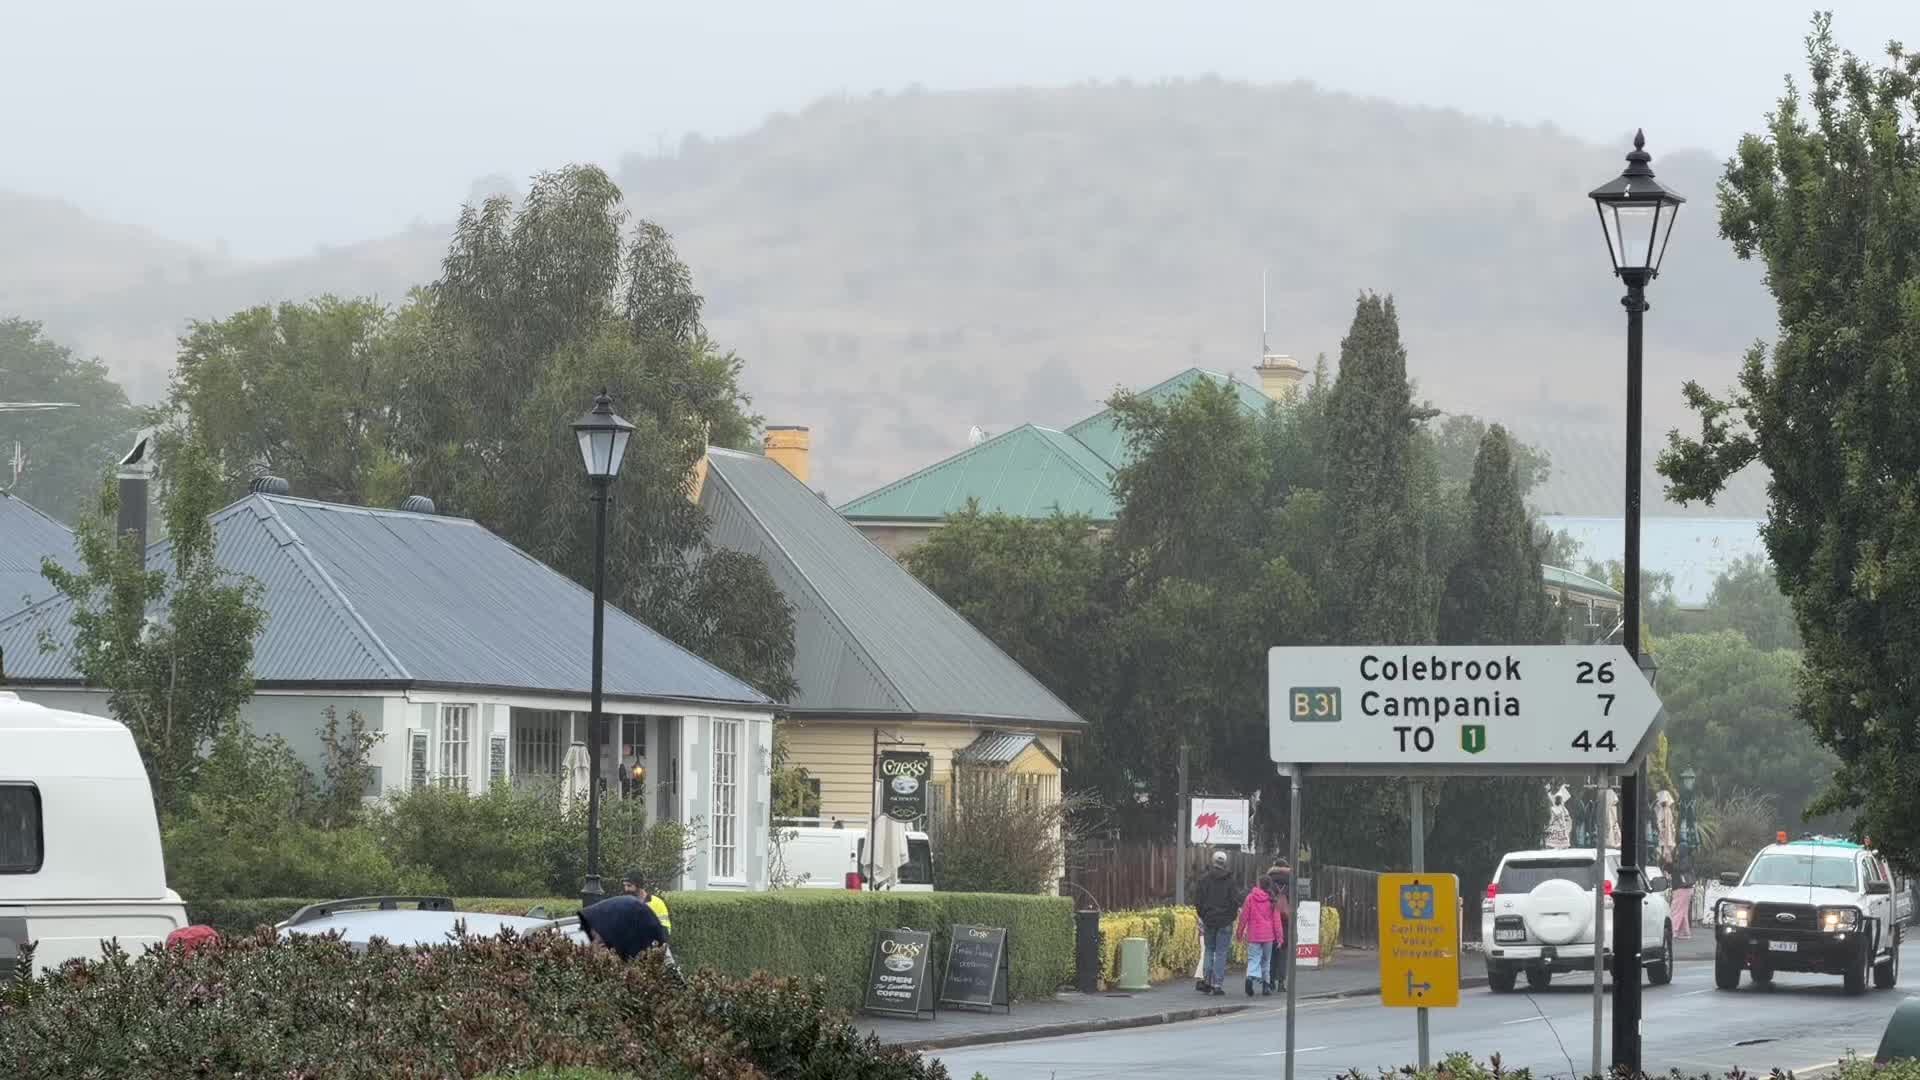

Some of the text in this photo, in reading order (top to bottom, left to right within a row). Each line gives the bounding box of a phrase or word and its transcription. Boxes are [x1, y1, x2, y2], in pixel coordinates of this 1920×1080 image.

[1360, 655, 1615, 684] Colebrook 26
[1294, 693, 1338, 717] B31
[1360, 691, 1616, 723] Campania 7
[1393, 726, 1617, 752] TO 1 44
[880, 975, 912, 984] OPEN
[876, 989, 912, 999] COFFEE
